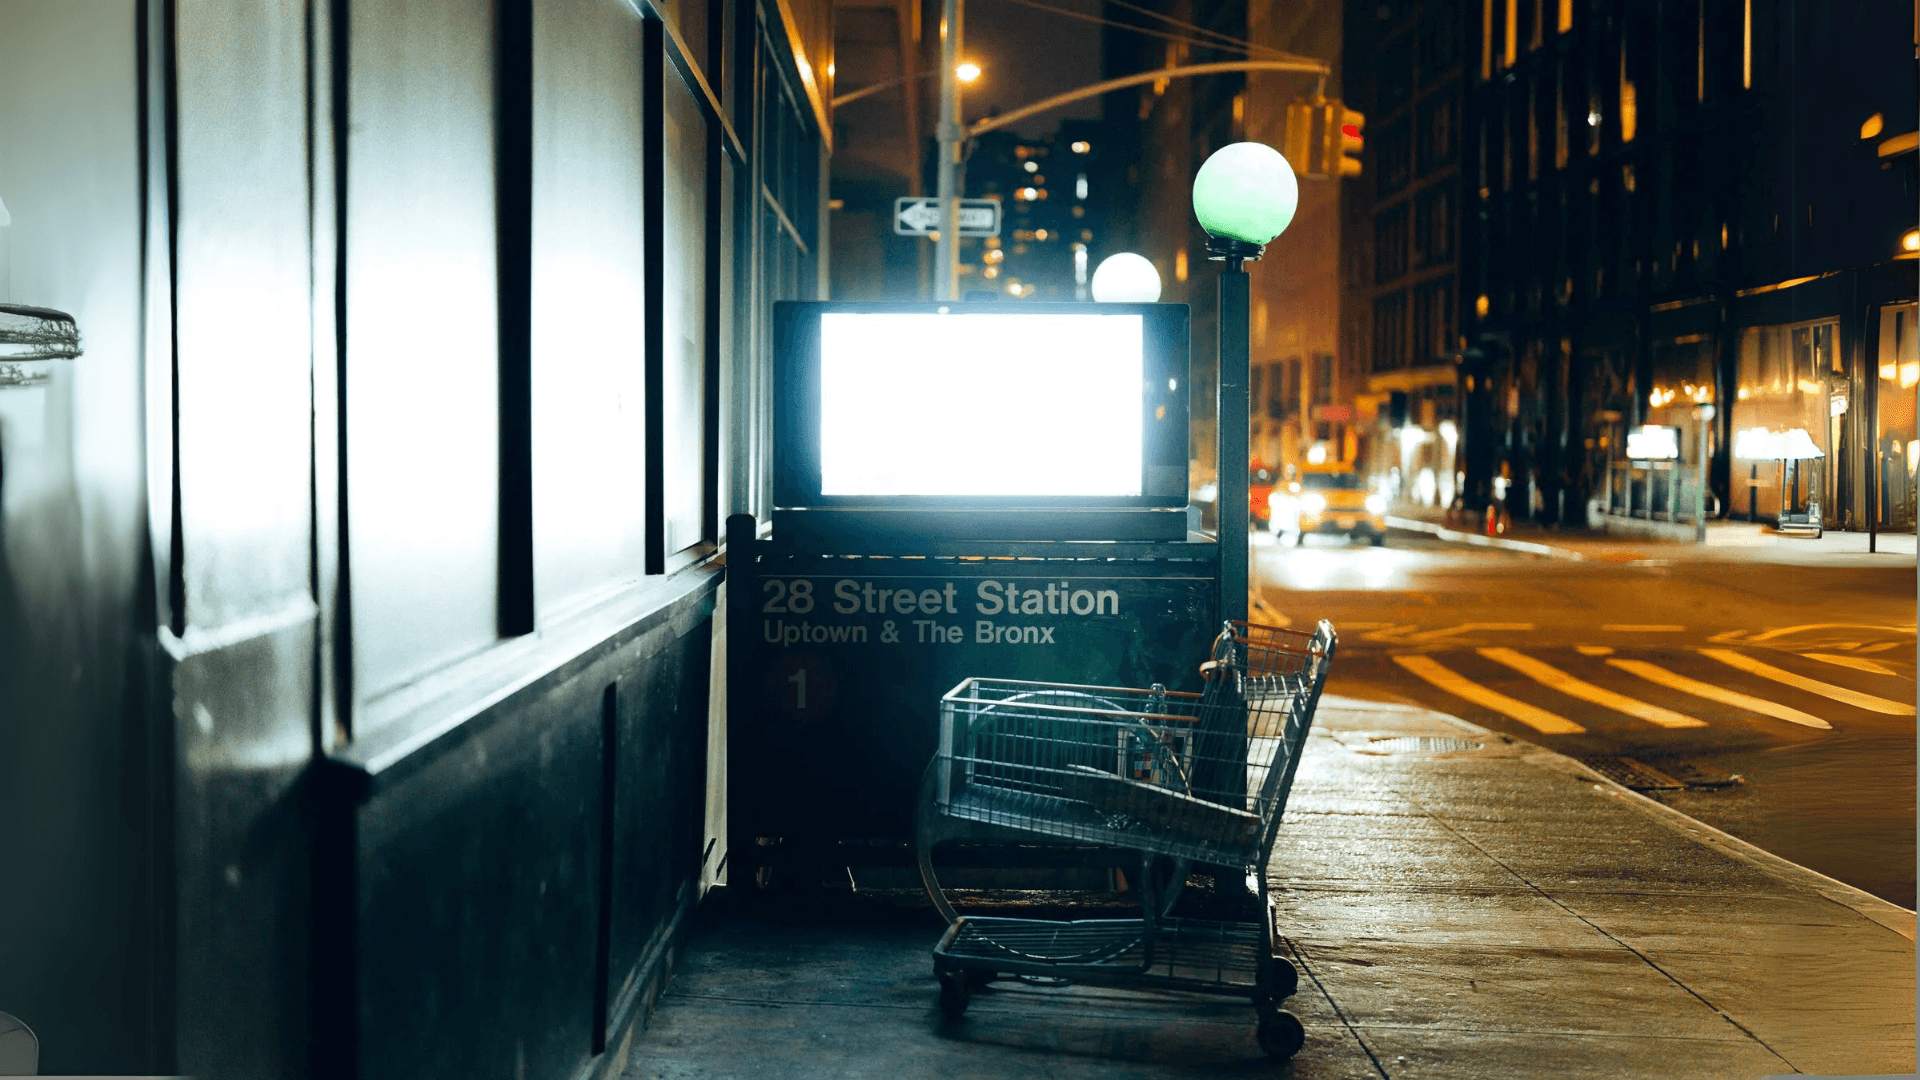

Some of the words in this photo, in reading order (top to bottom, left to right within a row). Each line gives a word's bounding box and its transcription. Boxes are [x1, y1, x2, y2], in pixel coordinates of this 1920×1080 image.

[763, 580, 814, 614] 28
[834, 580, 957, 614] Street
[976, 580, 1119, 615] Station
[764, 620, 867, 646] Uptown
[881, 620, 900, 643] &
[913, 621, 963, 643] The
[976, 621, 1055, 643] Bronx
[788, 669, 807, 709] 1
